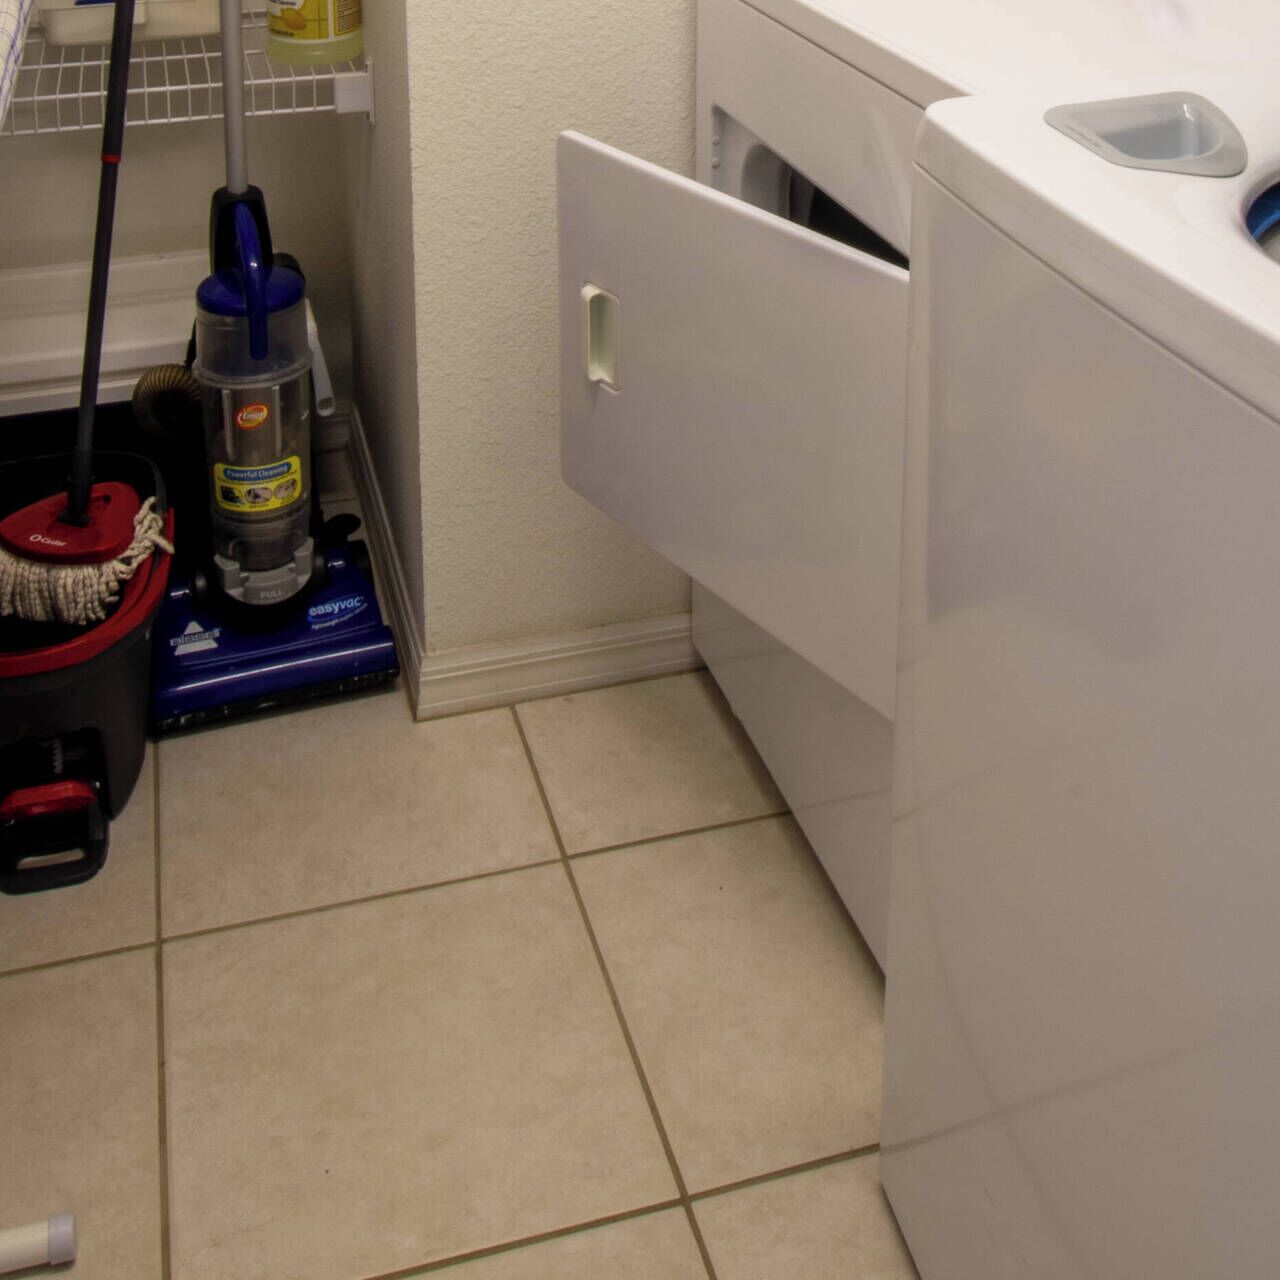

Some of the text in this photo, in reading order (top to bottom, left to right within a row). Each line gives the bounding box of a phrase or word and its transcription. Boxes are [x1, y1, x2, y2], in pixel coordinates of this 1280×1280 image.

[226, 464, 288, 480] Powerful Cleaning
[260, 589, 284, 600] PULL
[309, 596, 362, 616] easyvac
